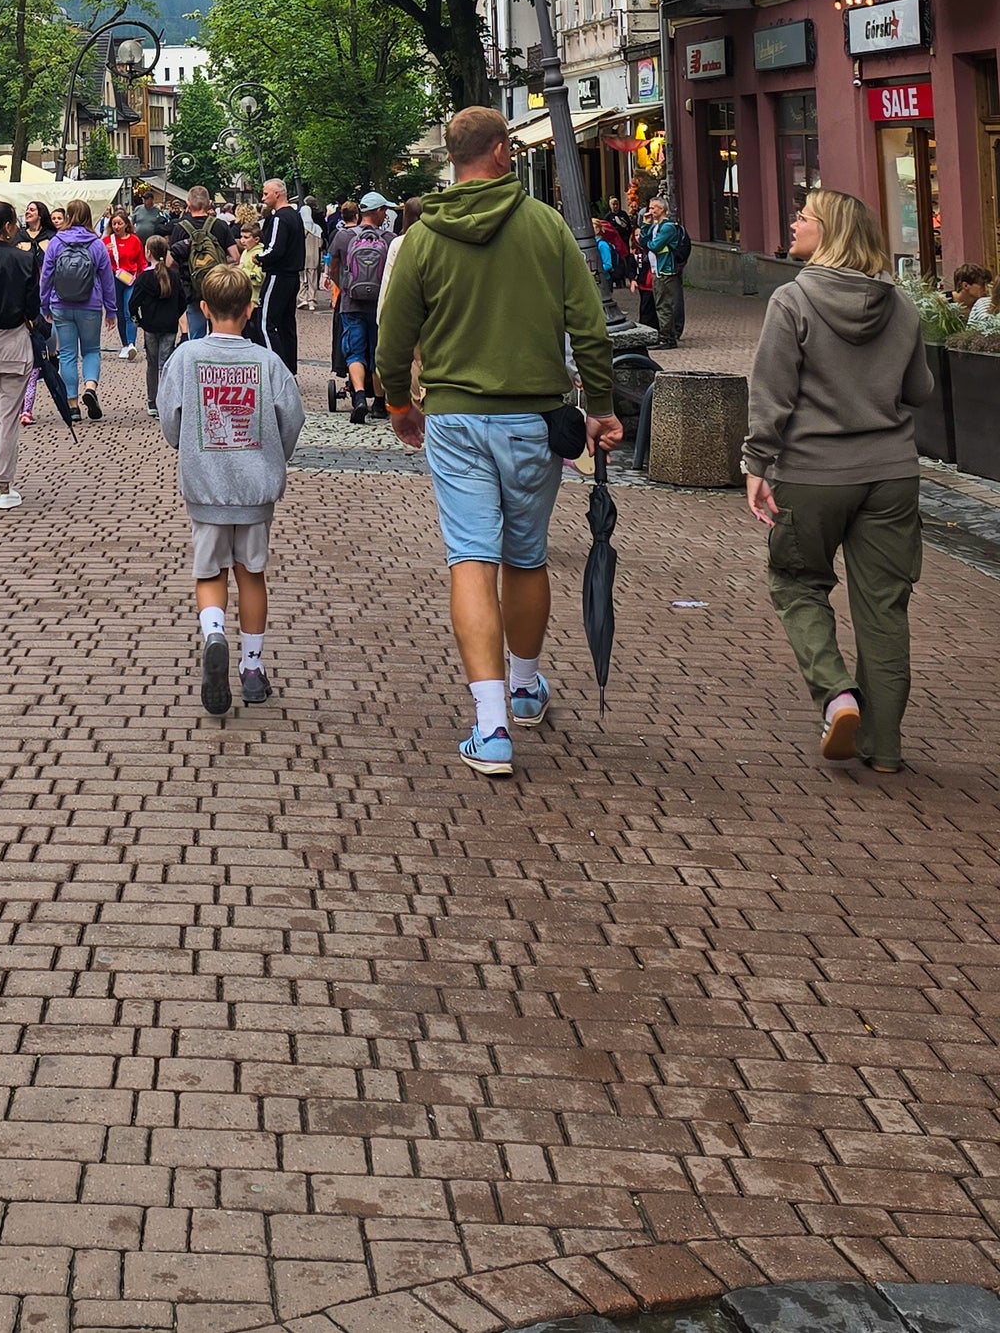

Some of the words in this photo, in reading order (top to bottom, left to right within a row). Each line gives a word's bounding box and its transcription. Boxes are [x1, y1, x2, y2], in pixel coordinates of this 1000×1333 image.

[865, 19, 892, 40] Górski
[882, 87, 919, 118] SALE
[203, 386, 255, 409] PIZZA
